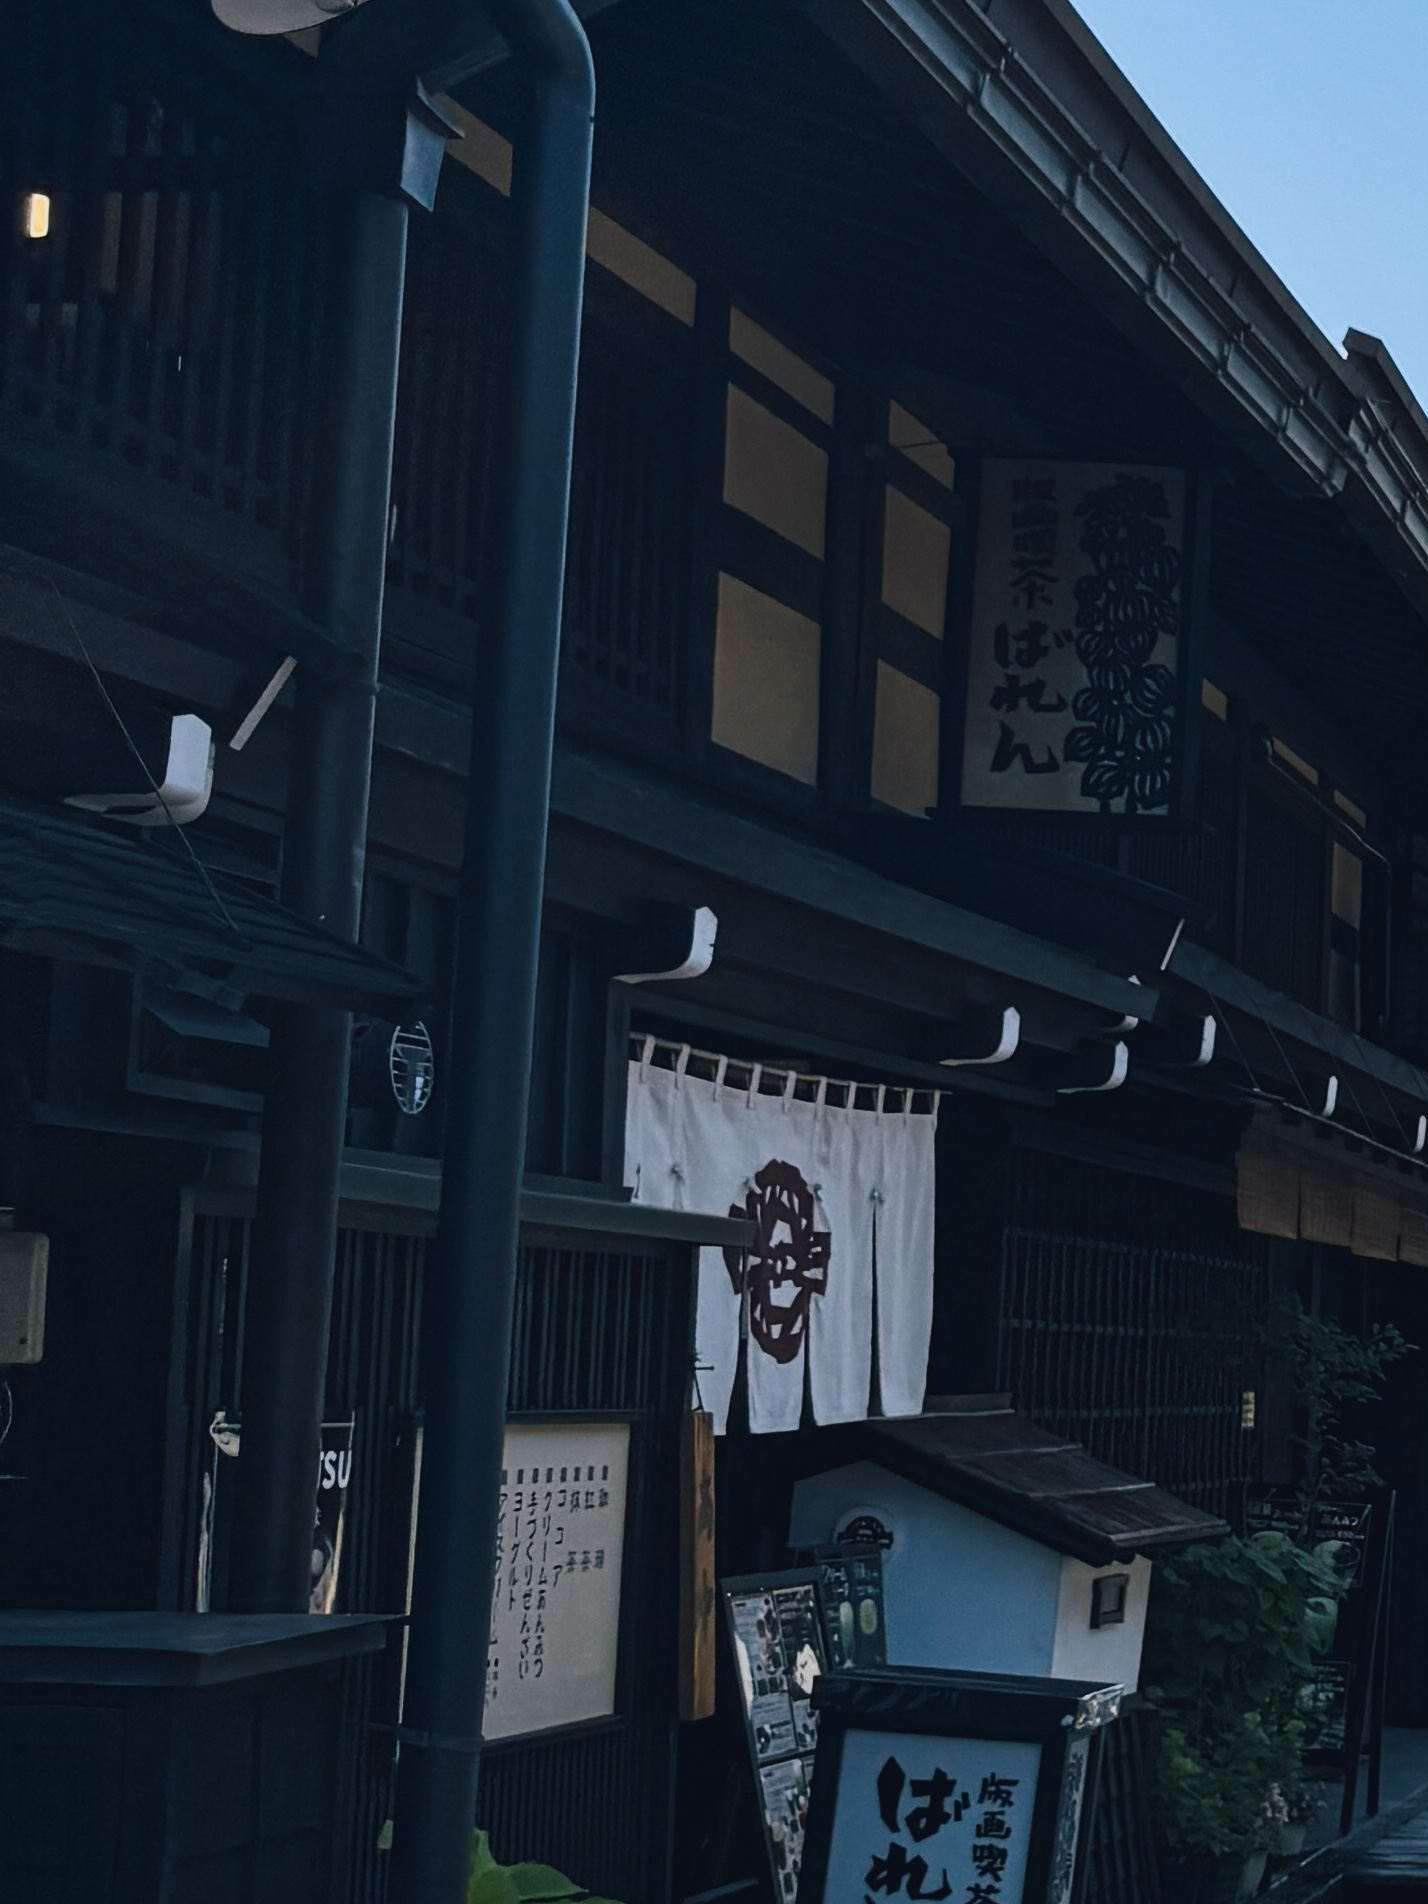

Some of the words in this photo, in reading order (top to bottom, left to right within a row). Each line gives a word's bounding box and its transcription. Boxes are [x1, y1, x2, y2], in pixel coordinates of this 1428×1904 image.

[509, 1492, 523, 1611] ヨーグルト
[519, 1491, 538, 1679] 手づくりぜんざい
[552, 1489, 567, 1587] ココア
